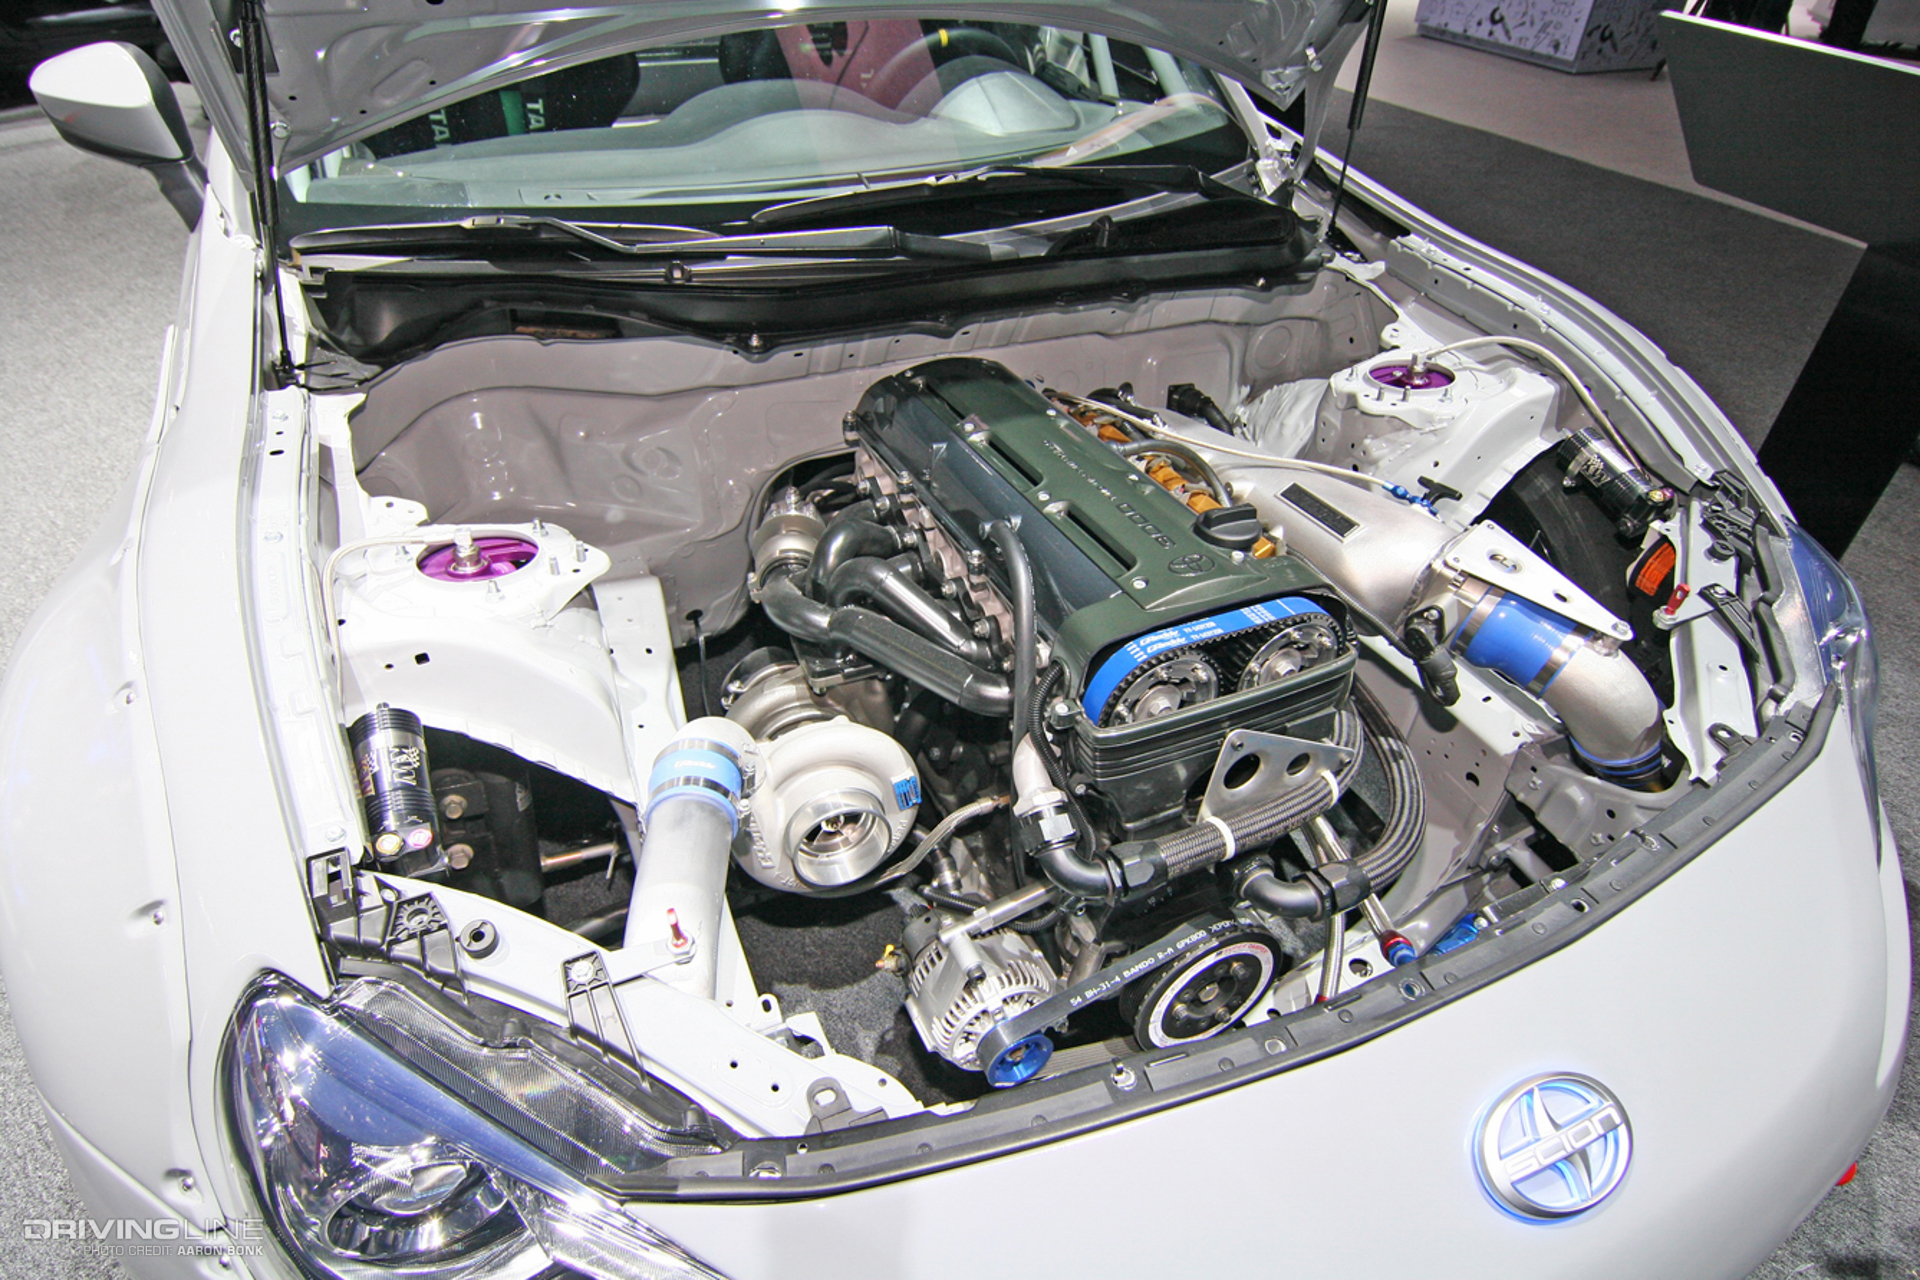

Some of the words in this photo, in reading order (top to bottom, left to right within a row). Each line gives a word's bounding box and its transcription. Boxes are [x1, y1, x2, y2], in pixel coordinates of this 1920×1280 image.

[1070, 995, 1083, 1007] 54
[1122, 957, 1156, 979] BANDO
[1156, 947, 1174, 960] R-A
[1504, 1105, 1622, 1181] SCION
